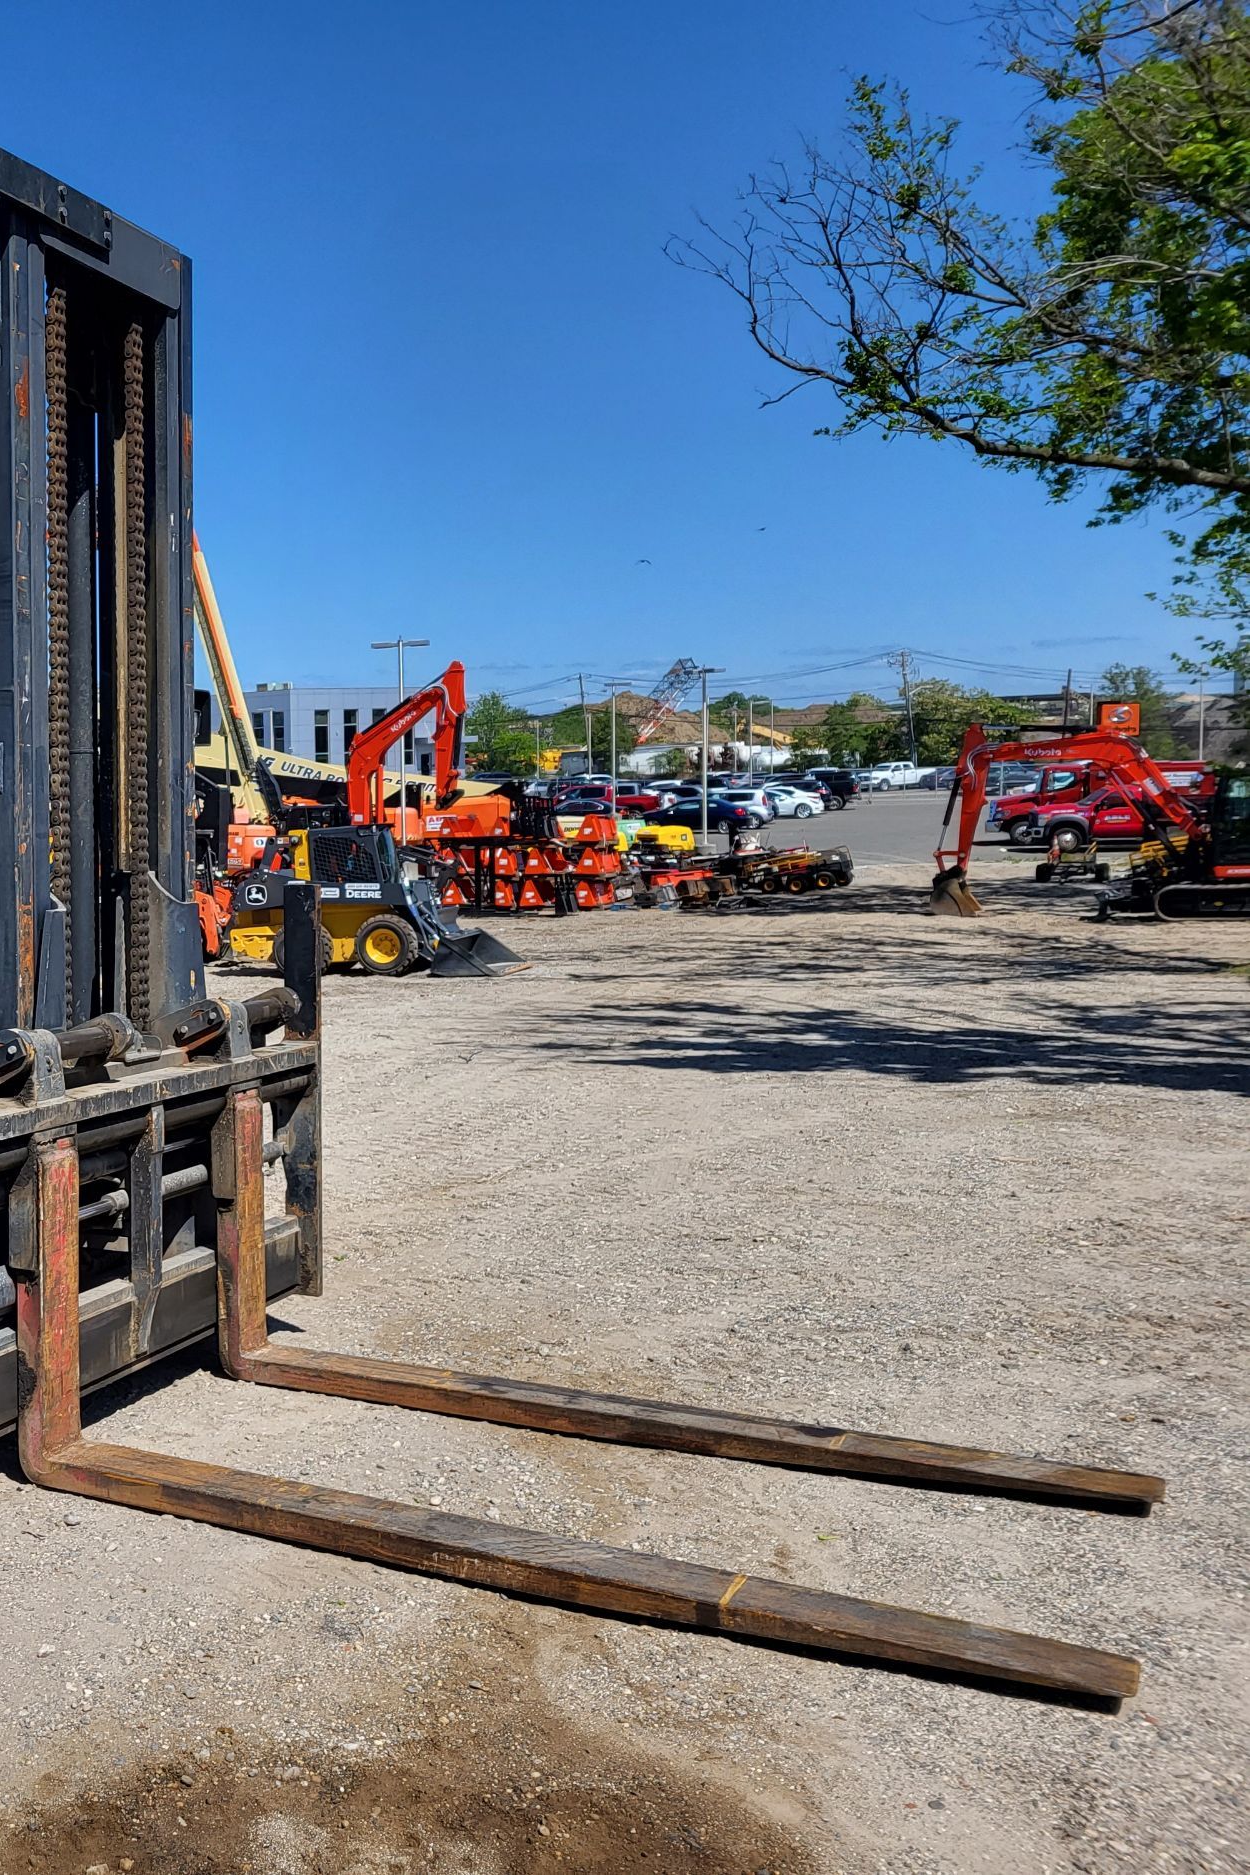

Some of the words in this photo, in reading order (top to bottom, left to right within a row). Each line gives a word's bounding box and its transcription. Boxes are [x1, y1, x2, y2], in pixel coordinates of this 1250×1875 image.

[1024, 748, 1062, 757] Kubota
[280, 761, 322, 781] ULTRA
[345, 889, 382, 899] DEERE
